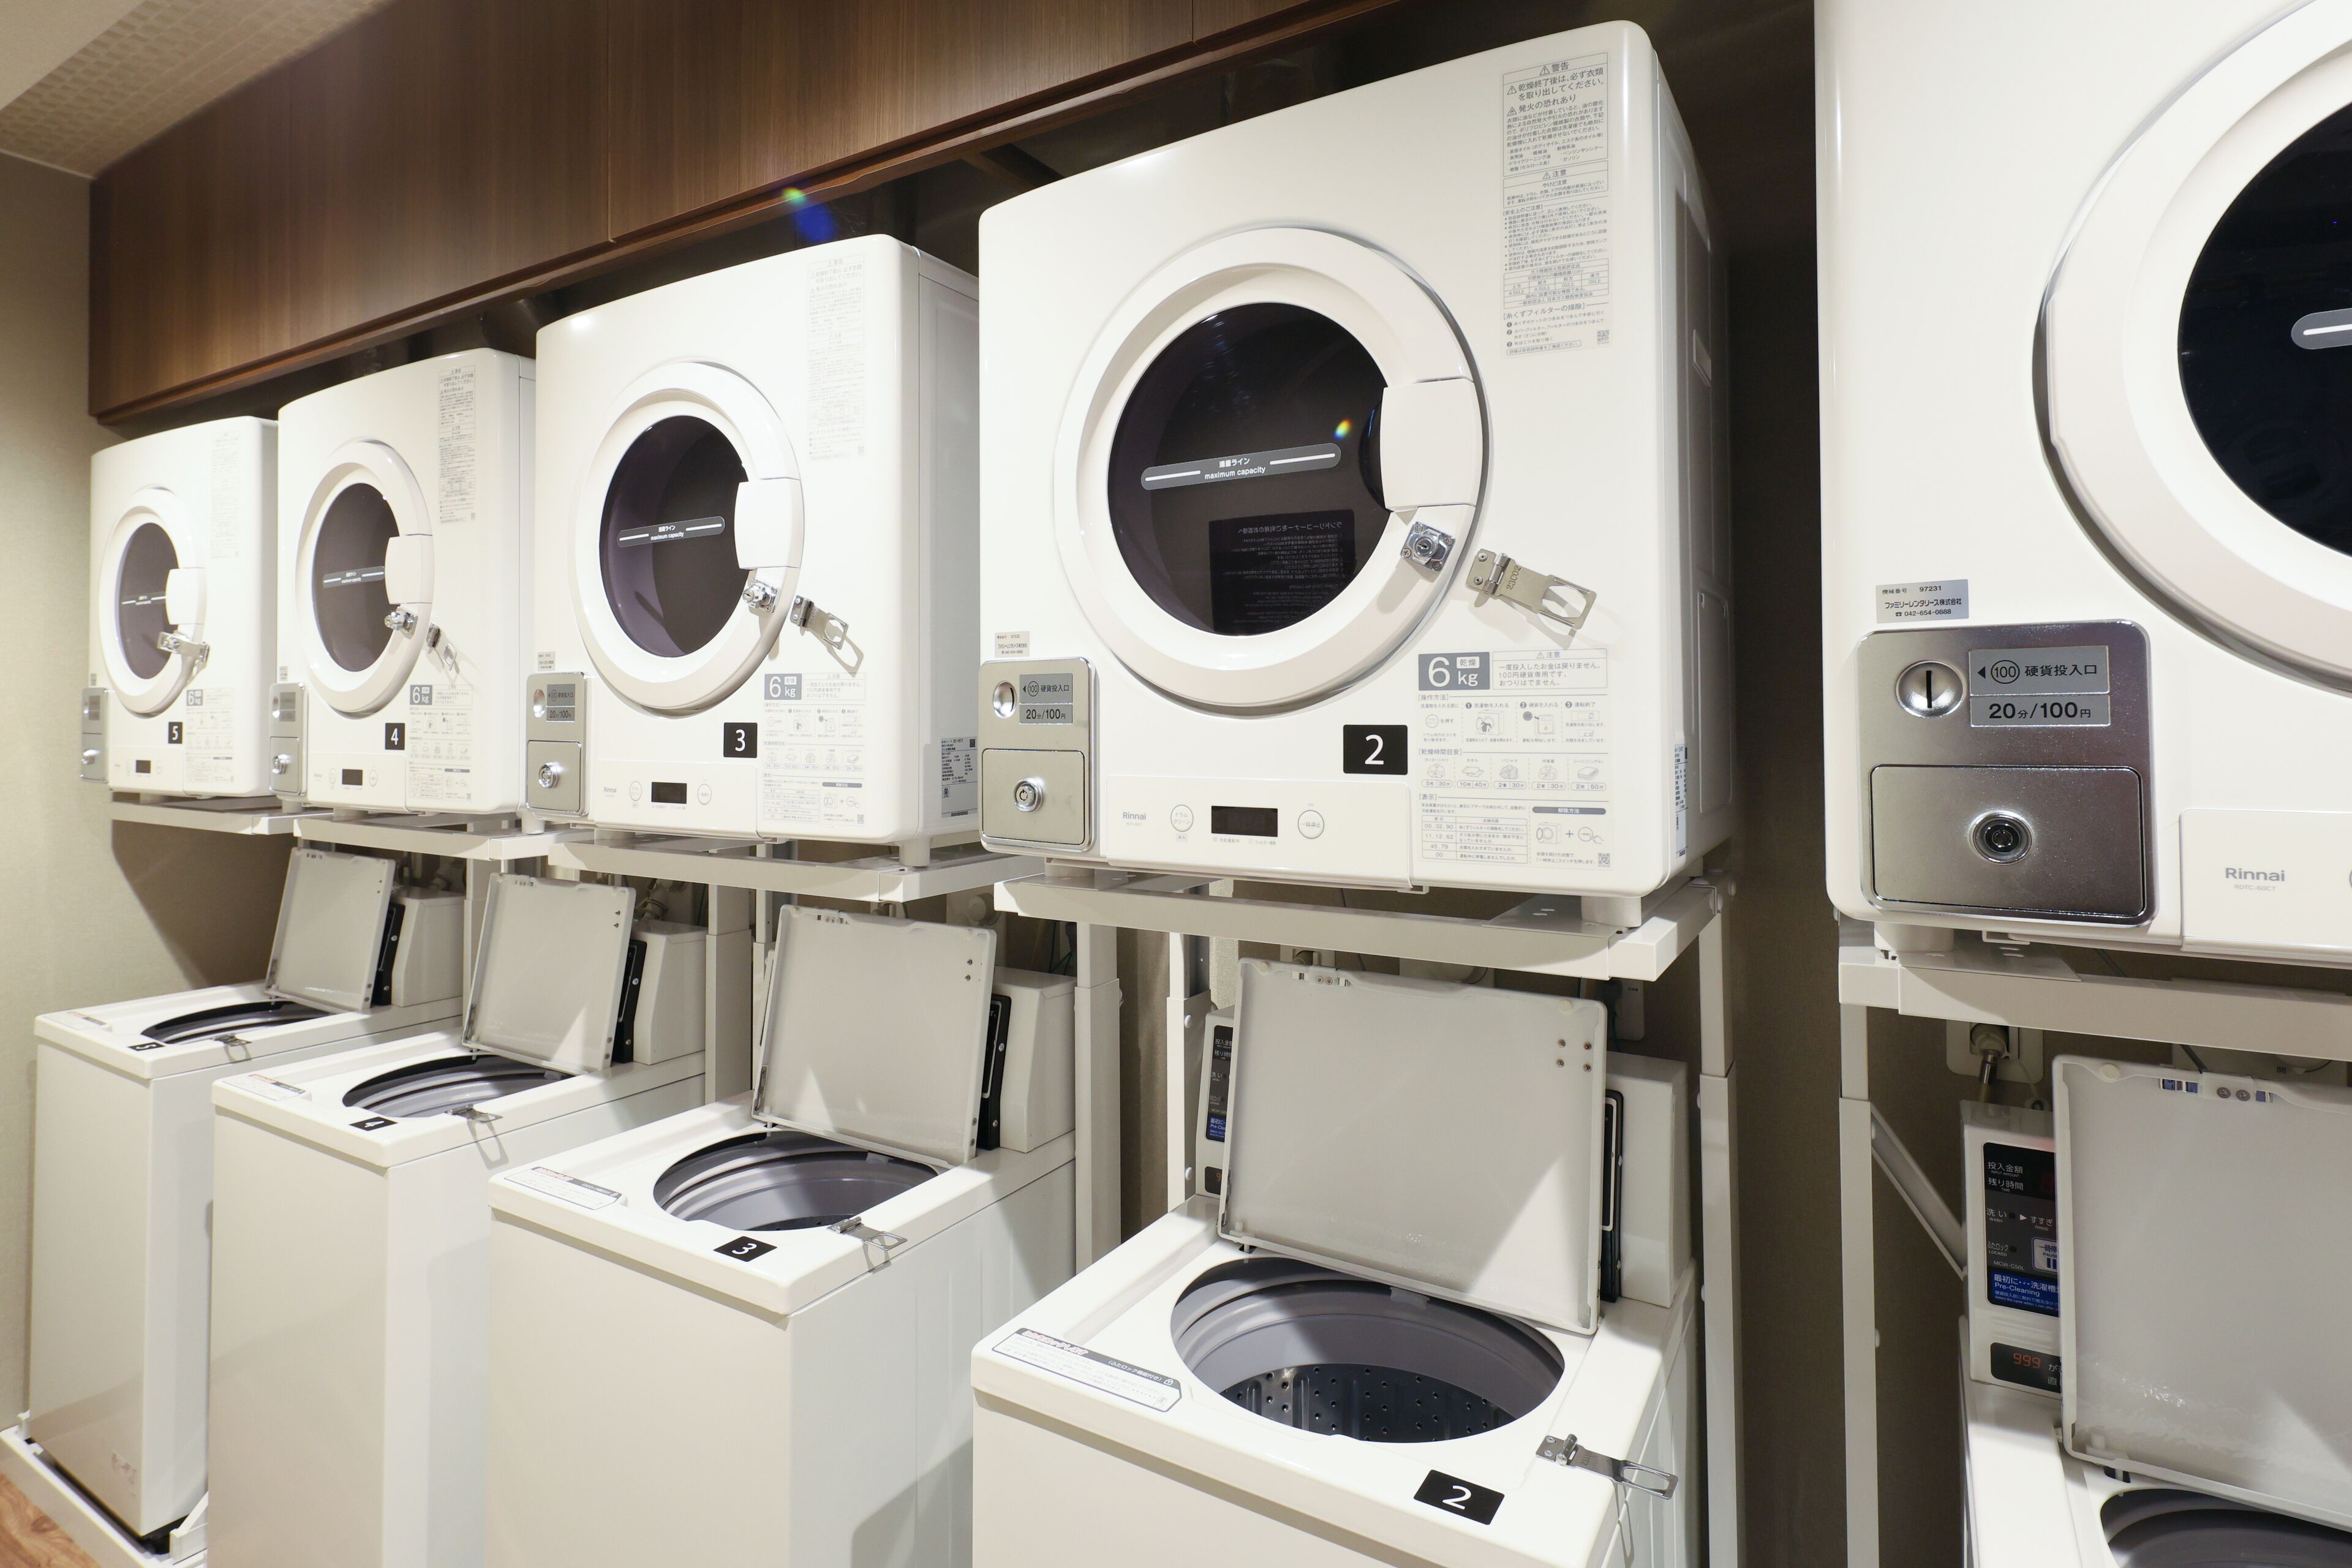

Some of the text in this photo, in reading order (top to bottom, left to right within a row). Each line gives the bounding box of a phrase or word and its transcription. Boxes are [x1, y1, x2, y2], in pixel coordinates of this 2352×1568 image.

[1551, 62, 1569, 72] 警告
[1519, 67, 1604, 91] 乾燥終了後は、必ず衣類
[1519, 78, 1604, 100] を取り出してください。
[1519, 94, 1576, 113] 発火の恐れあり
[1204, 466, 1266, 480] maximum capacity
[1885, 598, 1962, 609] ファミリーレンタリース株式会社
[1904, 608, 1951, 617] 042-654-0888
[1428, 657, 1450, 687] 6
[1458, 671, 1478, 686] kg
[1994, 665, 2097, 678] 100 硬貨投入口
[769, 676, 782, 698] 6
[785, 687, 796, 697] kg
[188, 691, 195, 705] 6
[412, 687, 420, 703] 6
[1026, 709, 1066, 720] 20分/100円
[1989, 701, 2091, 720] 20分/100円
[172, 726, 178, 741] 5
[391, 728, 399, 745] 4
[735, 729, 745, 752] 3
[1364, 734, 1384, 765] 2
[1122, 811, 1147, 821] Rinnai
[2225, 867, 2285, 881] Rinnai
[1988, 1161, 2023, 1174] 投入金額
[1988, 1177, 2024, 1190] 残り時間
[2030, 1216, 2053, 1226] すすぎ
[731, 1243, 757, 1255] 3
[1988, 1242, 2008, 1251] ふたロック
[1994, 1283, 2040, 1297] Pre-Cleaning
[2013, 1353, 2041, 1369] 999
[1442, 1485, 1471, 1510] 2
